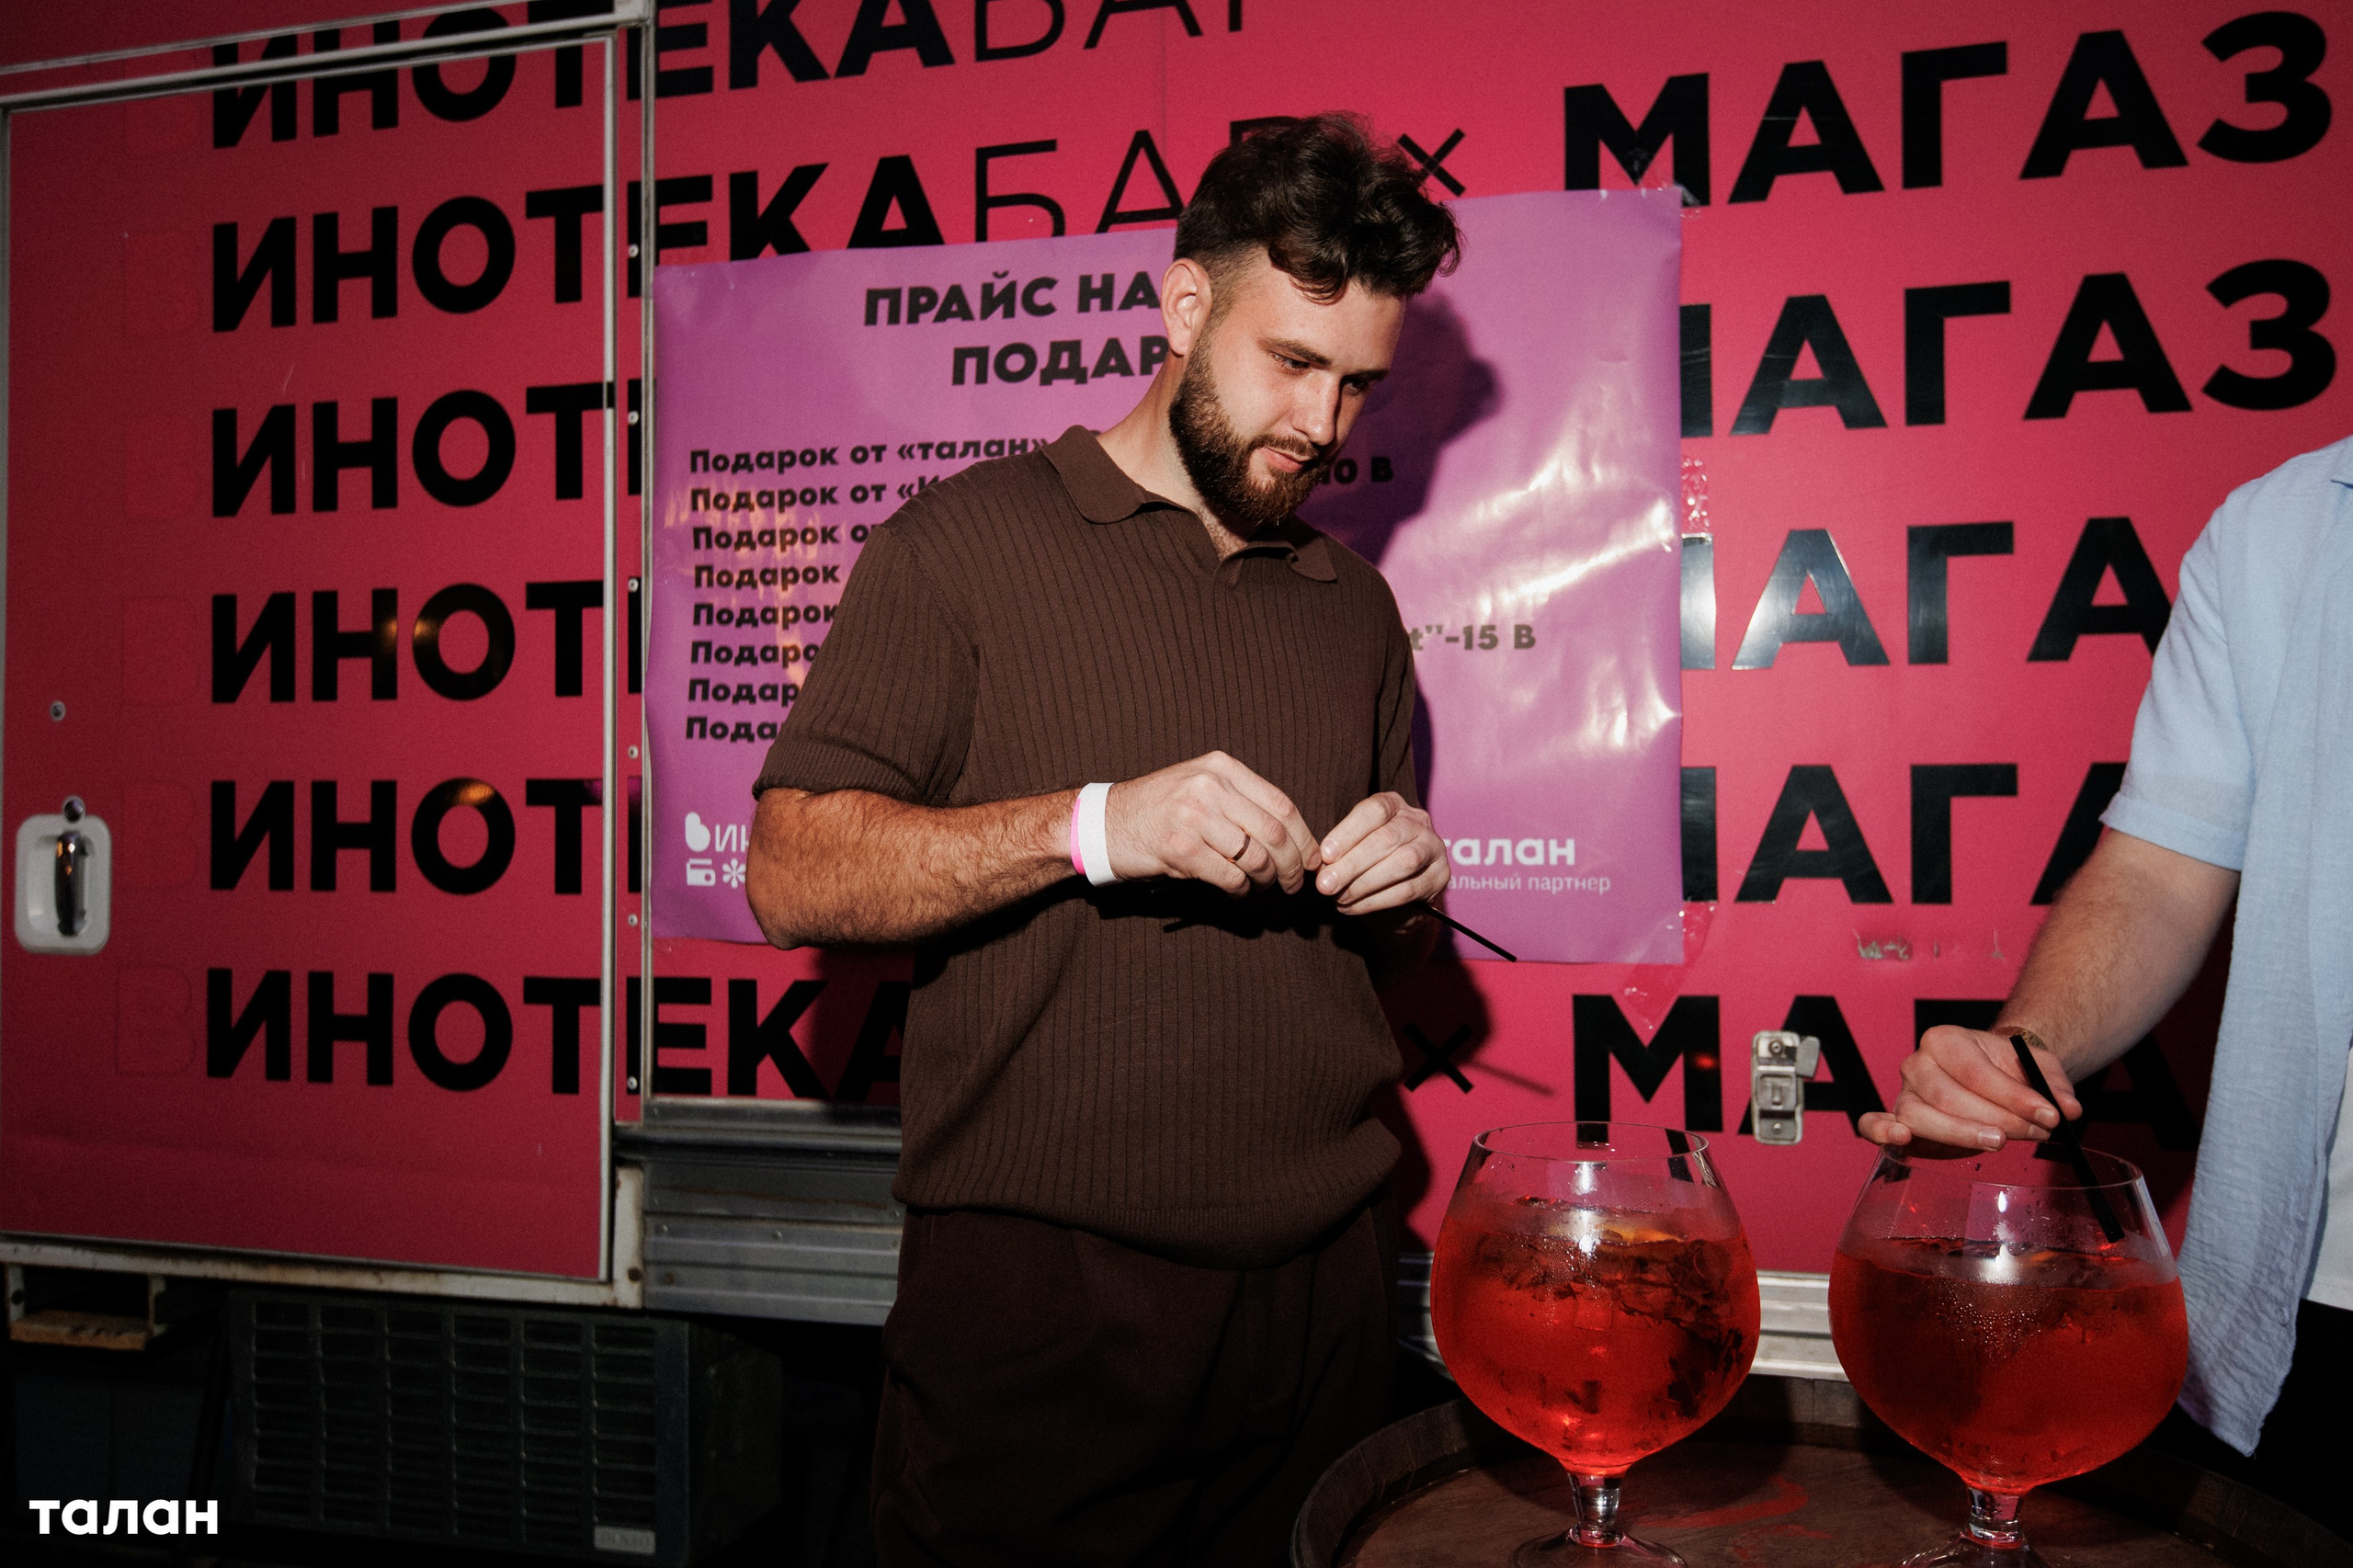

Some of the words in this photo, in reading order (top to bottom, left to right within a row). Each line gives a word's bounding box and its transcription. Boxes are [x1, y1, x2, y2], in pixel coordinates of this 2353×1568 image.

[864, 271, 1058, 326] ПРАЙС
[1077, 272, 1163, 313] НА
[212, 378, 655, 517] ИНОТ
[689, 446, 839, 475] Подарок
[850, 444, 887, 465] от
[690, 483, 839, 514] Подарок
[850, 483, 887, 503] от
[692, 524, 840, 552] Подарок
[850, 523, 873, 543] о
[694, 563, 841, 591] Подарок
[211, 576, 642, 704] ИНОТ
[686, 716, 784, 744] Пода
[210, 776, 642, 896] ИНОТ
[1528, 875, 1611, 895] партнер
